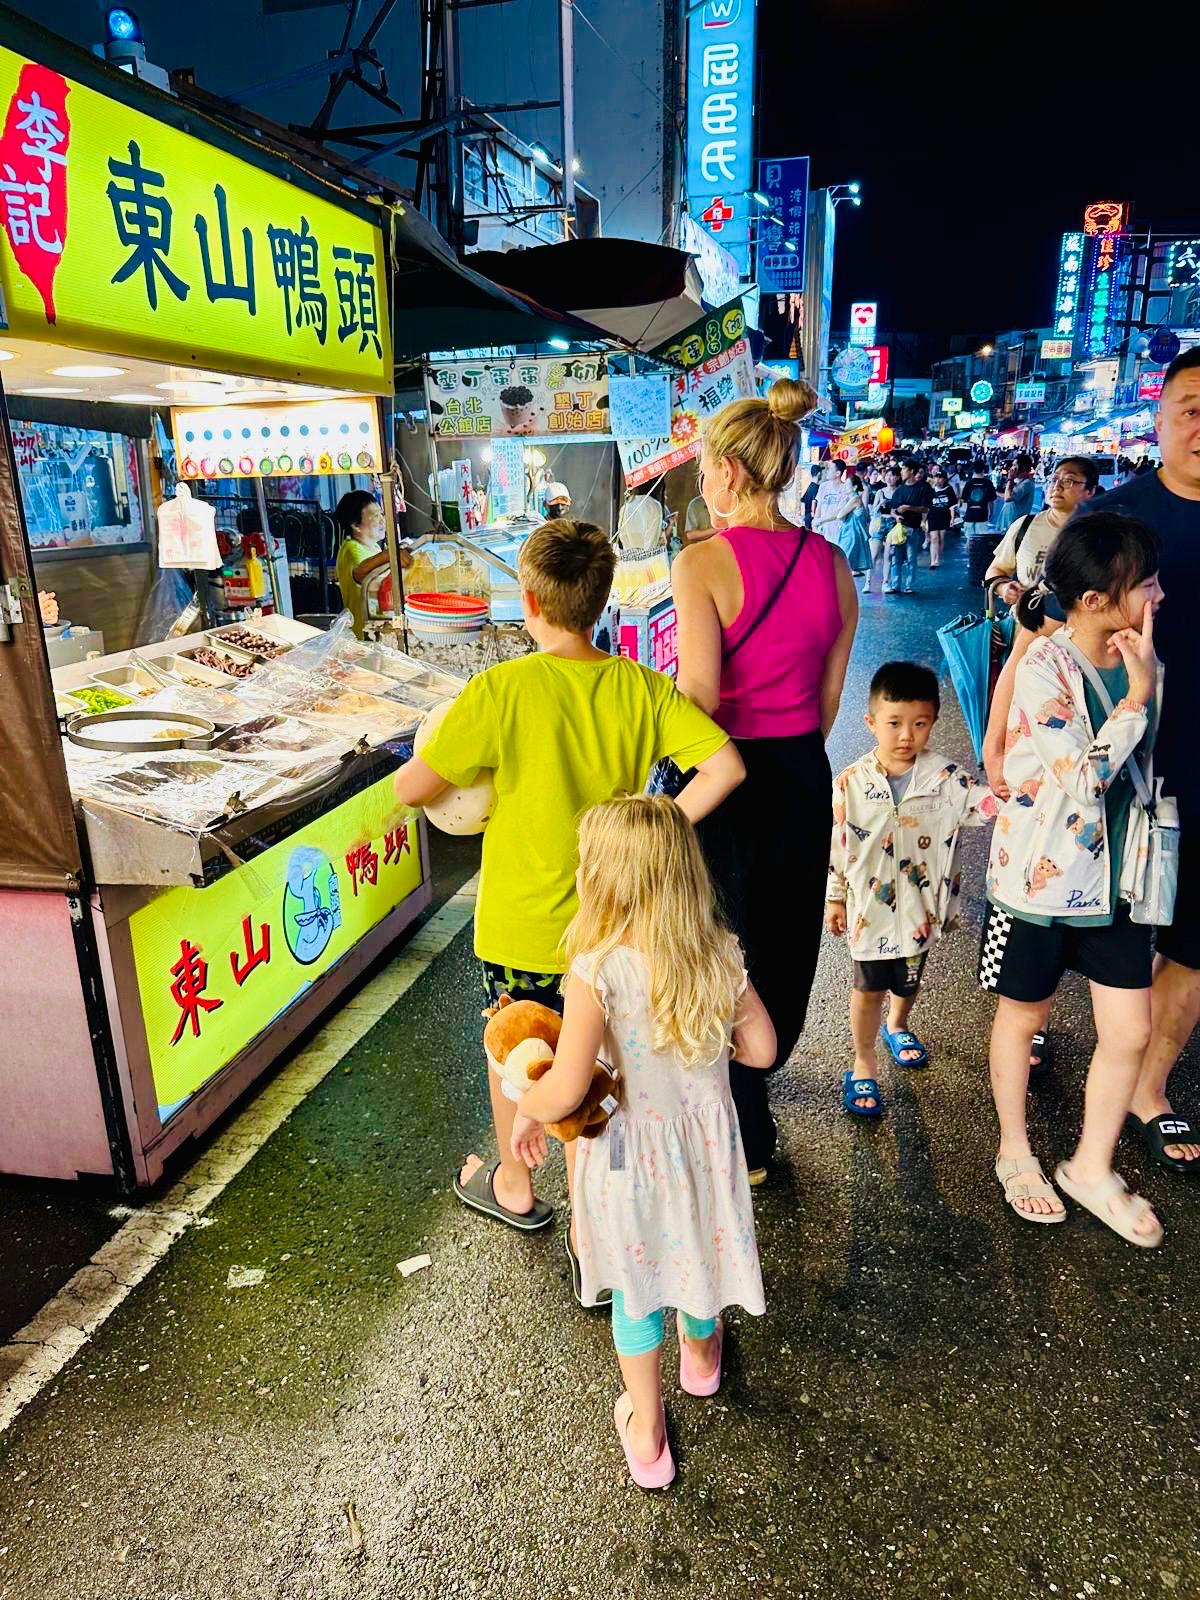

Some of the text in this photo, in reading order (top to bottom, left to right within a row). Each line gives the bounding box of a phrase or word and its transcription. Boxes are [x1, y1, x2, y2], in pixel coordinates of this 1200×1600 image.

[702, 42, 740, 183] 屈臣氏
[0, 90, 68, 254] 李記
[106, 139, 383, 360] 東山鴨頭
[446, 397, 483, 415] 台北
[554, 391, 593, 410] 墾丁
[440, 415, 492, 435] 公館店
[547, 411, 604, 430] 創始店
[864, 782, 890, 800] Paris
[169, 913, 271, 1047] 東山
[1158, 1120, 1191, 1135] GP
